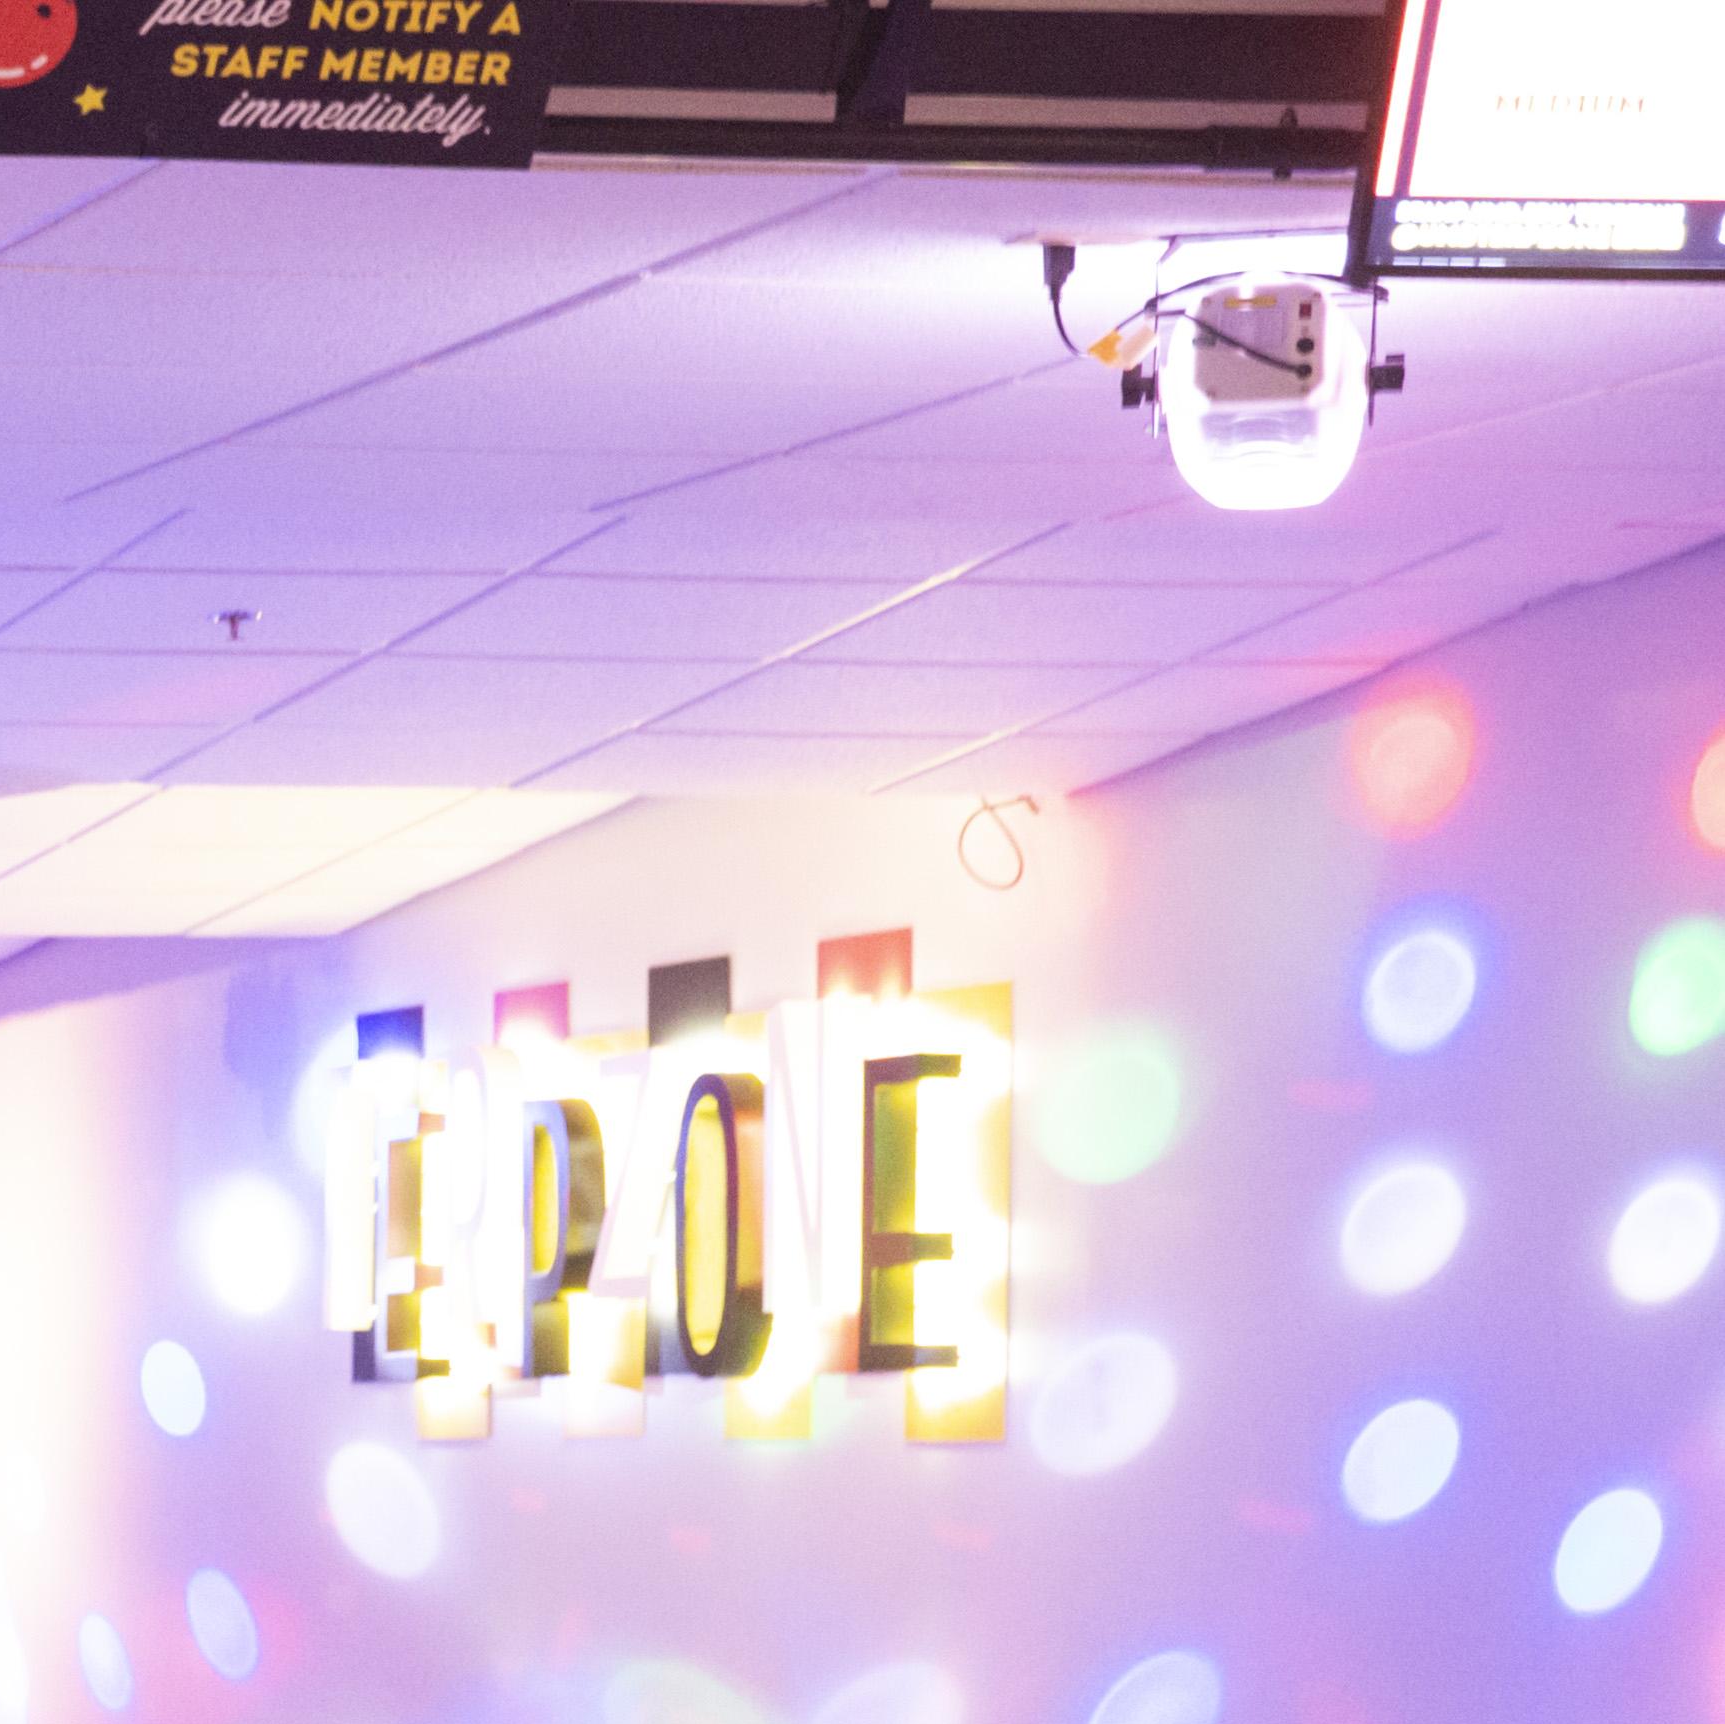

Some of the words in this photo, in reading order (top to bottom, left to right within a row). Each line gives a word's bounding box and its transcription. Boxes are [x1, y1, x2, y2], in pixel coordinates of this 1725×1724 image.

[309, 0, 481, 35] NOTIFY
[489, 2, 522, 35] A
[170, 43, 309, 80] STAFF
[319, 49, 512, 86] MEMBER
[218, 90, 491, 148] immediately.
